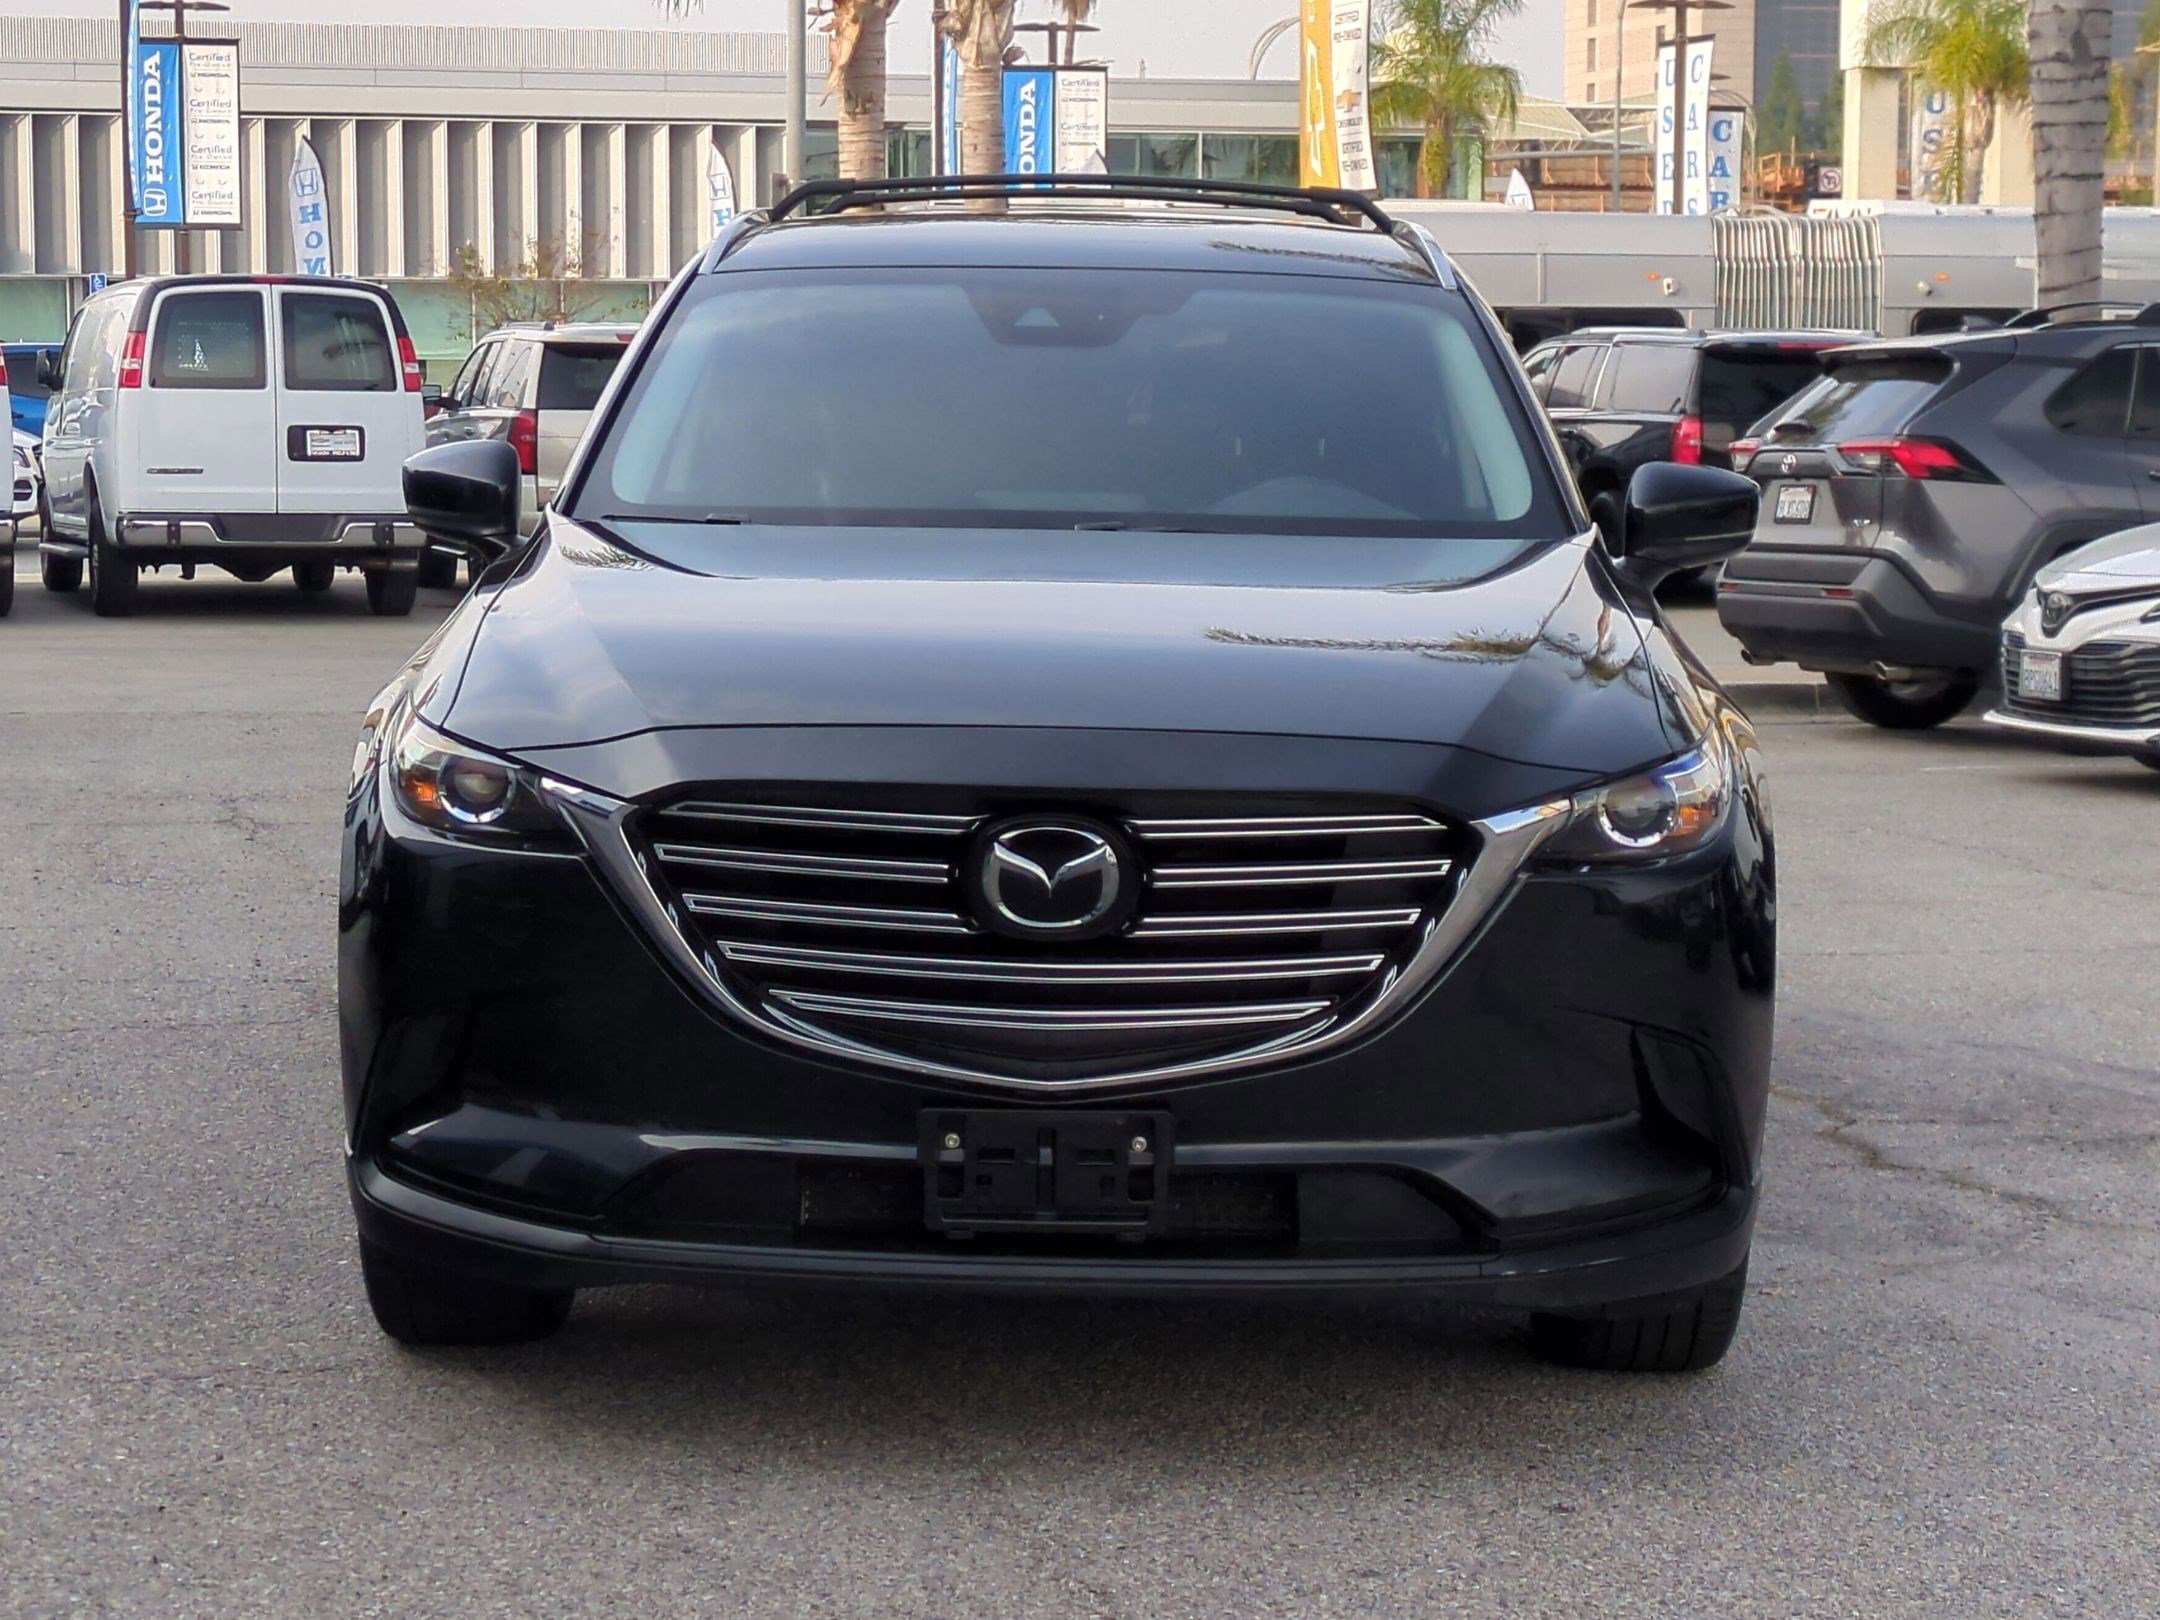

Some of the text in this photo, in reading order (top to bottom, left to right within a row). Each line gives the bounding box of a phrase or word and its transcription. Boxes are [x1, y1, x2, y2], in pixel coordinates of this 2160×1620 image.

[189, 52, 231, 61] Certified
[190, 98, 232, 108] Certified
[144, 51, 163, 184] HONDA
[190, 144, 233, 154] Certified
[191, 190, 233, 200] Certified
